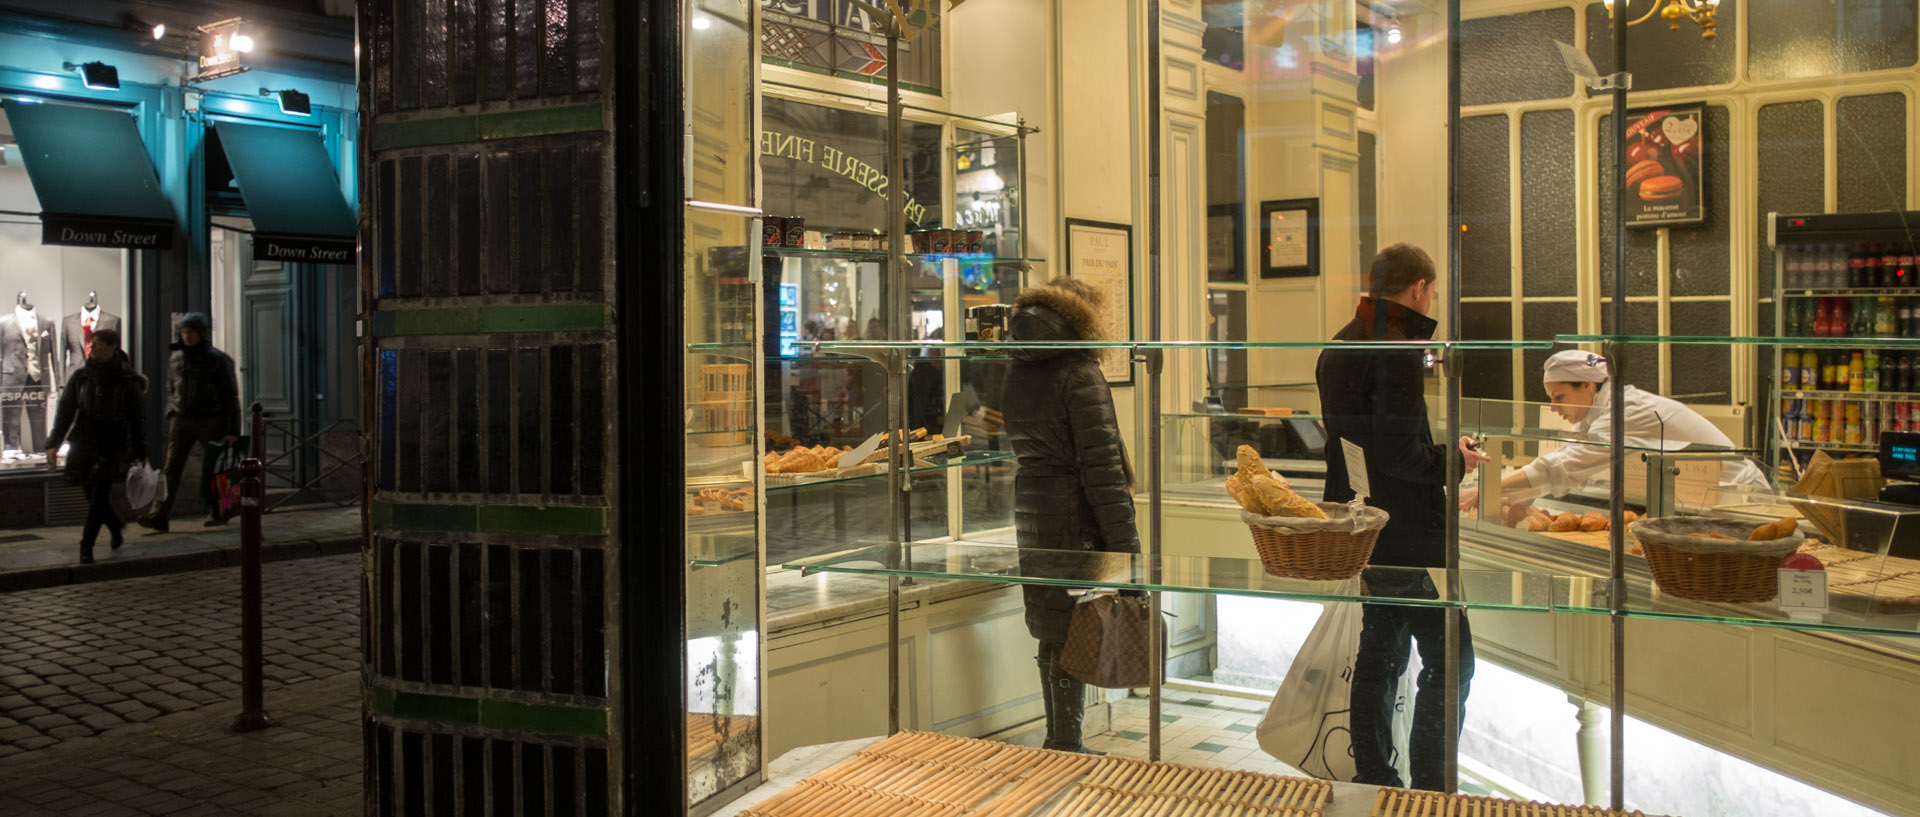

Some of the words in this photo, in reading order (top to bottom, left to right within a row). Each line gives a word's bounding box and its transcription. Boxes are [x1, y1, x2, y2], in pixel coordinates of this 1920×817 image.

[1626, 113, 1656, 138] OUVEAU
[1643, 204, 1652, 212] Le
[61, 227, 107, 243] Down
[111, 229, 157, 245] Street
[267, 243, 305, 258] Down
[309, 246, 348, 260] Street
[1791, 587, 1813, 595] 2,50€
